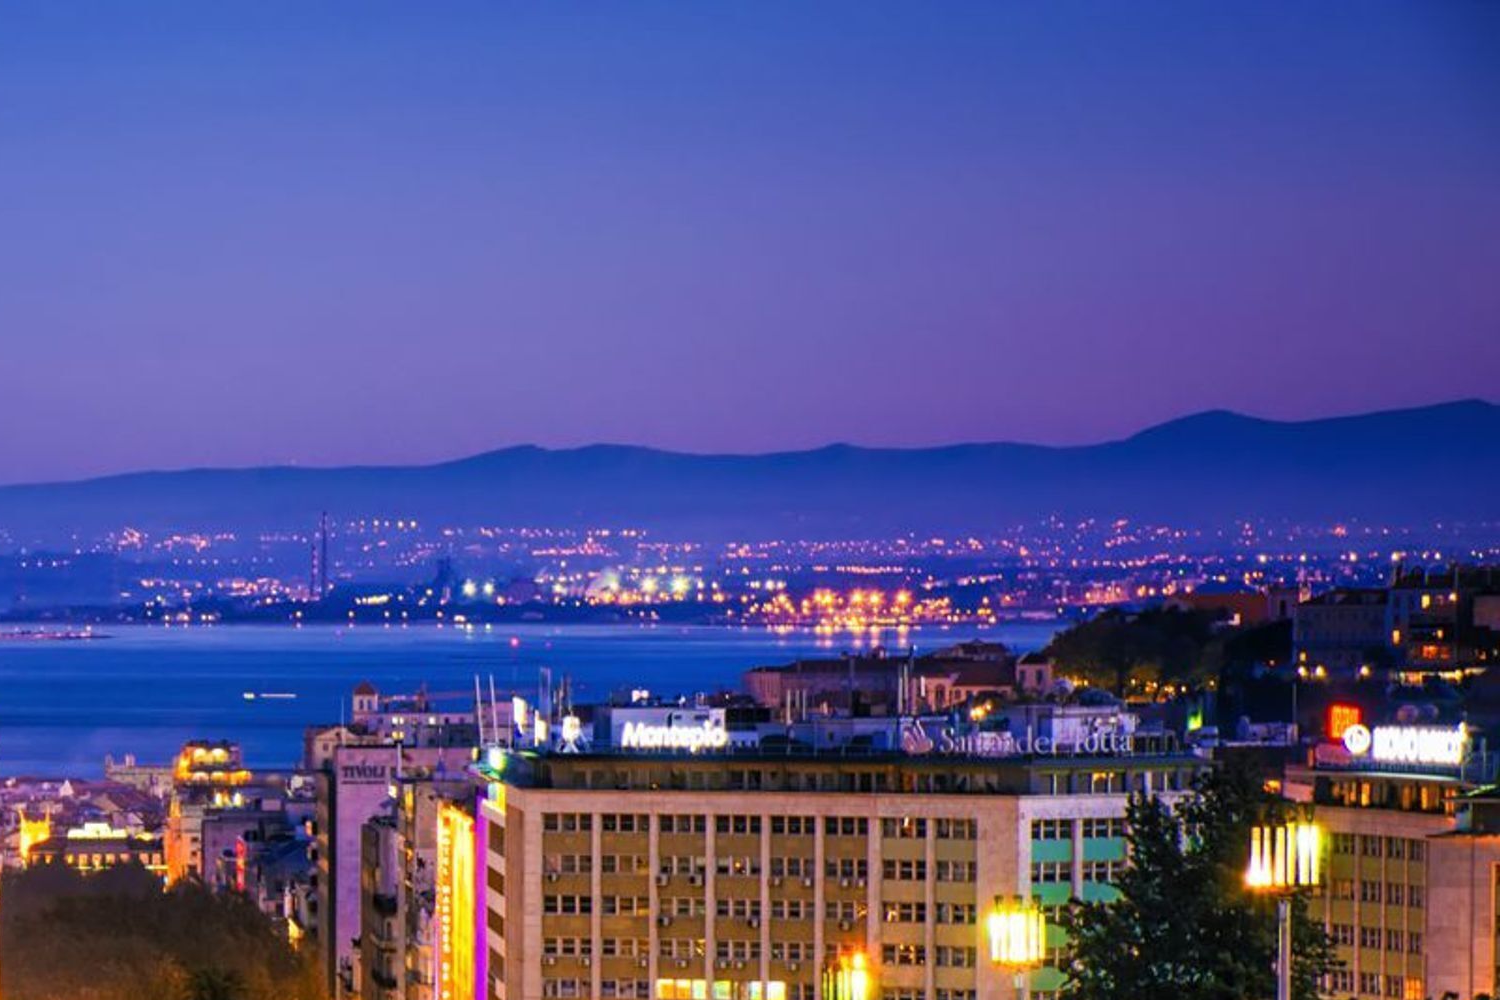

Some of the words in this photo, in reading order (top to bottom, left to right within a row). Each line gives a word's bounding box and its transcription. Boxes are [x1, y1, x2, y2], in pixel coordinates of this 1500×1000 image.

[621, 721, 728, 753] Montepio
[939, 725, 1059, 755] Santander
[1074, 724, 1134, 753] Totta
[341, 765, 386, 778] TIVOLI
